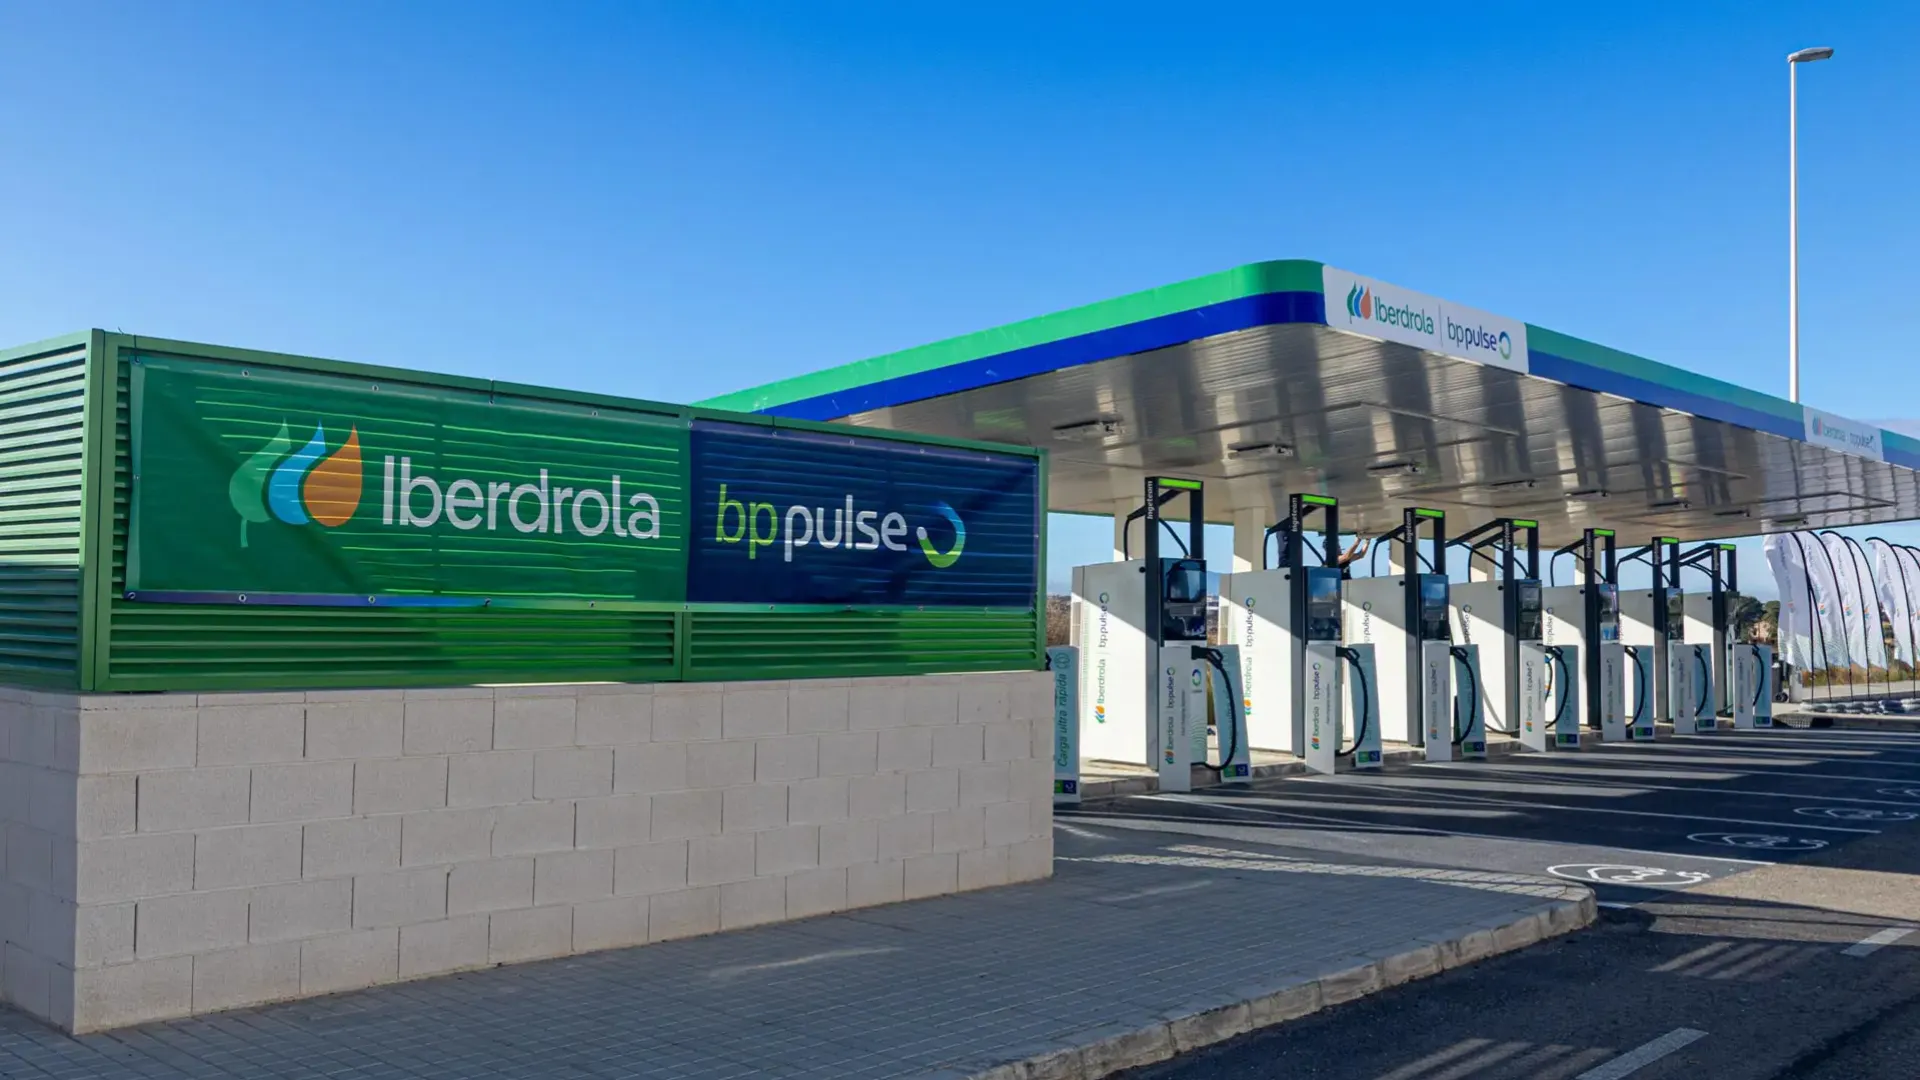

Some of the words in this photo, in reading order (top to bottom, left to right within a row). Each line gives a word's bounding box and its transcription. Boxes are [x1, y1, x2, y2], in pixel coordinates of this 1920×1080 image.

[1374, 296, 1434, 335] Iberdrola
[383, 455, 660, 541] Iberdrola
[1146, 481, 1154, 519] Ingeteam
[1291, 497, 1299, 532] Ingeteam
[1097, 659, 1106, 704] Iberdrola
[1244, 657, 1253, 698] Iberdrola
[1056, 710, 1068, 734] ultra
[1166, 717, 1174, 749] Iberdrola
[1312, 706, 1320, 737] Iberdrola
[1057, 736, 1070, 767] Carga
